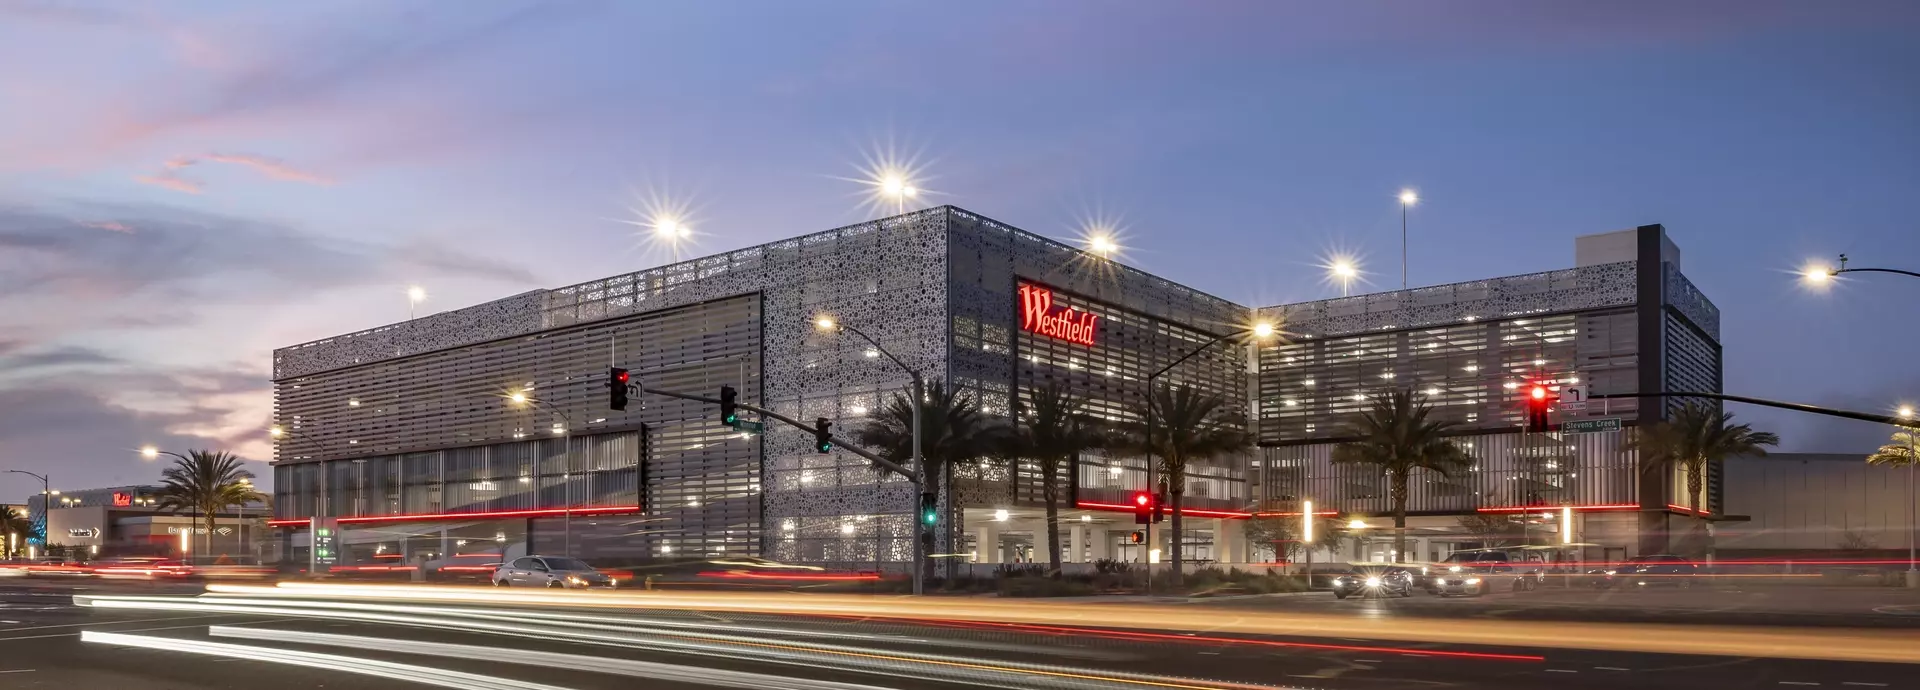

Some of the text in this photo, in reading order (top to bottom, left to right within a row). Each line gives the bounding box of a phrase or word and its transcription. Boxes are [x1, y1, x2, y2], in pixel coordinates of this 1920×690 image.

[1020, 285, 1097, 345] Westfield
[1566, 419, 1616, 429] Stevens Creek
